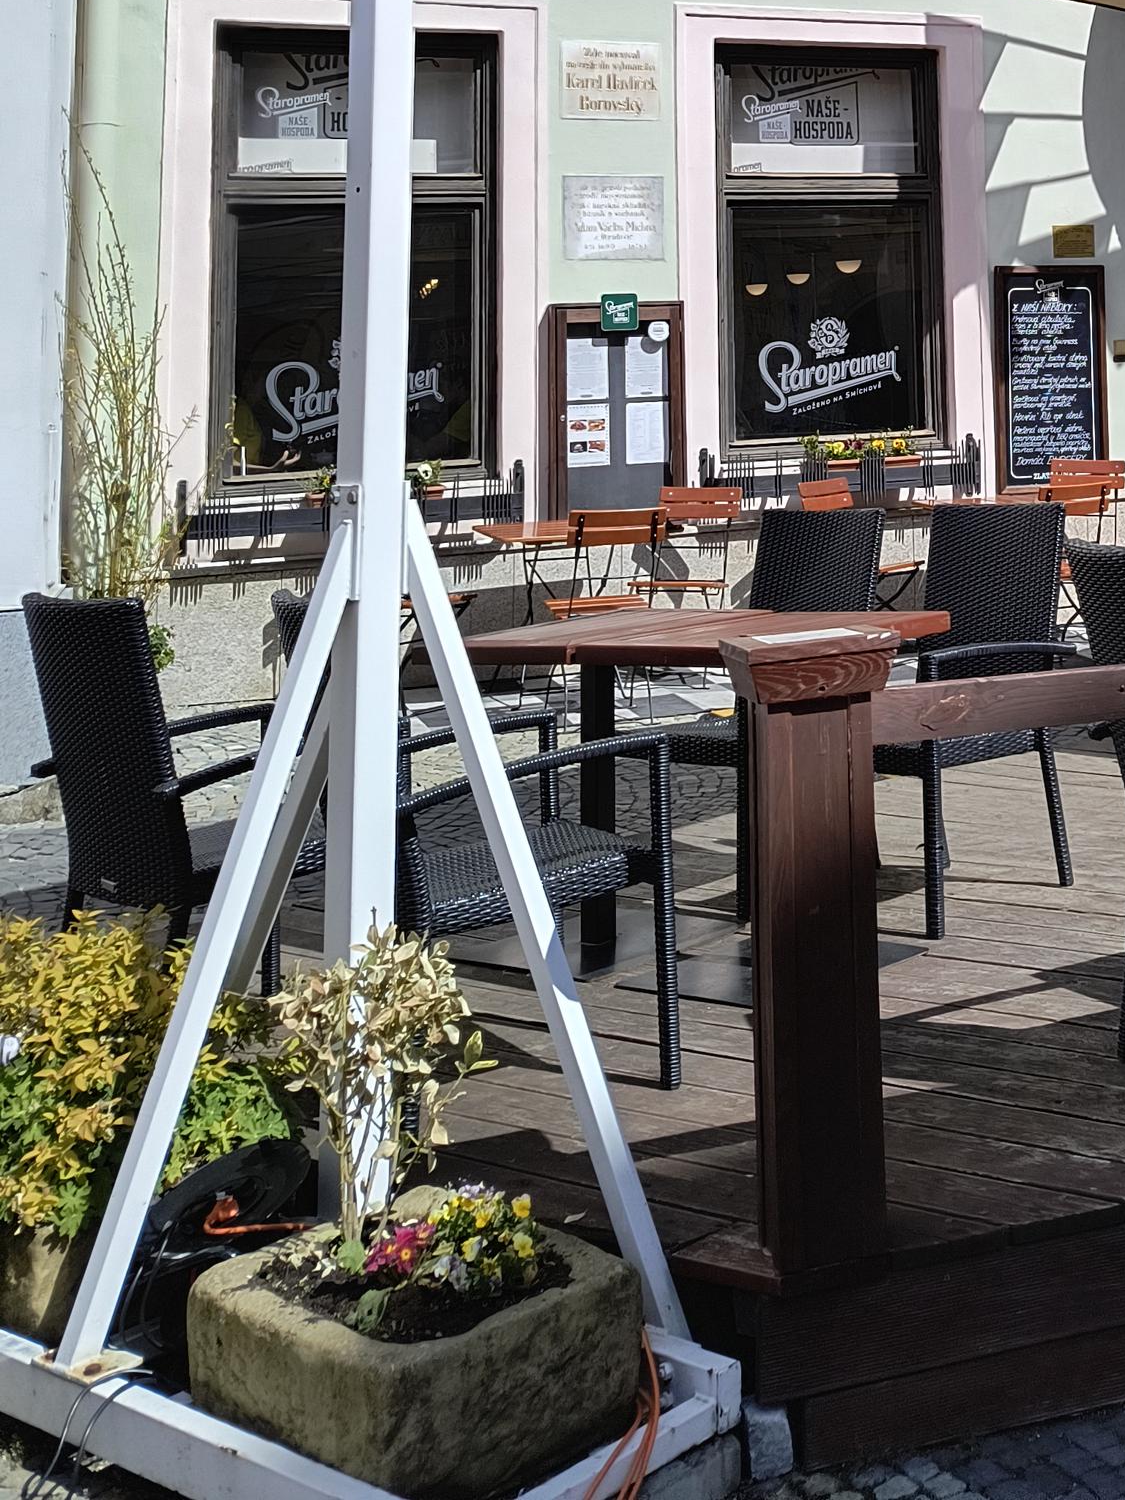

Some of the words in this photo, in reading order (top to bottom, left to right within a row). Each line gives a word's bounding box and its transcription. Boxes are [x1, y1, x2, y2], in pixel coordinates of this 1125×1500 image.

[566, 73, 602, 89] Karel
[607, 74, 657, 90] Havlíček
[256, 86, 332, 118] Staropramen
[741, 94, 802, 123] Staropramen
[806, 96, 840, 117] NAŠE
[288, 115, 309, 127] NAŠE
[793, 121, 853, 139] HOSPODA
[281, 127, 315, 138] HOSPODA
[758, 341, 902, 413] Staropramen
[265, 361, 444, 443] Staren
[792, 398, 831, 416] ZALOŽENO
[833, 395, 843, 403] NA
